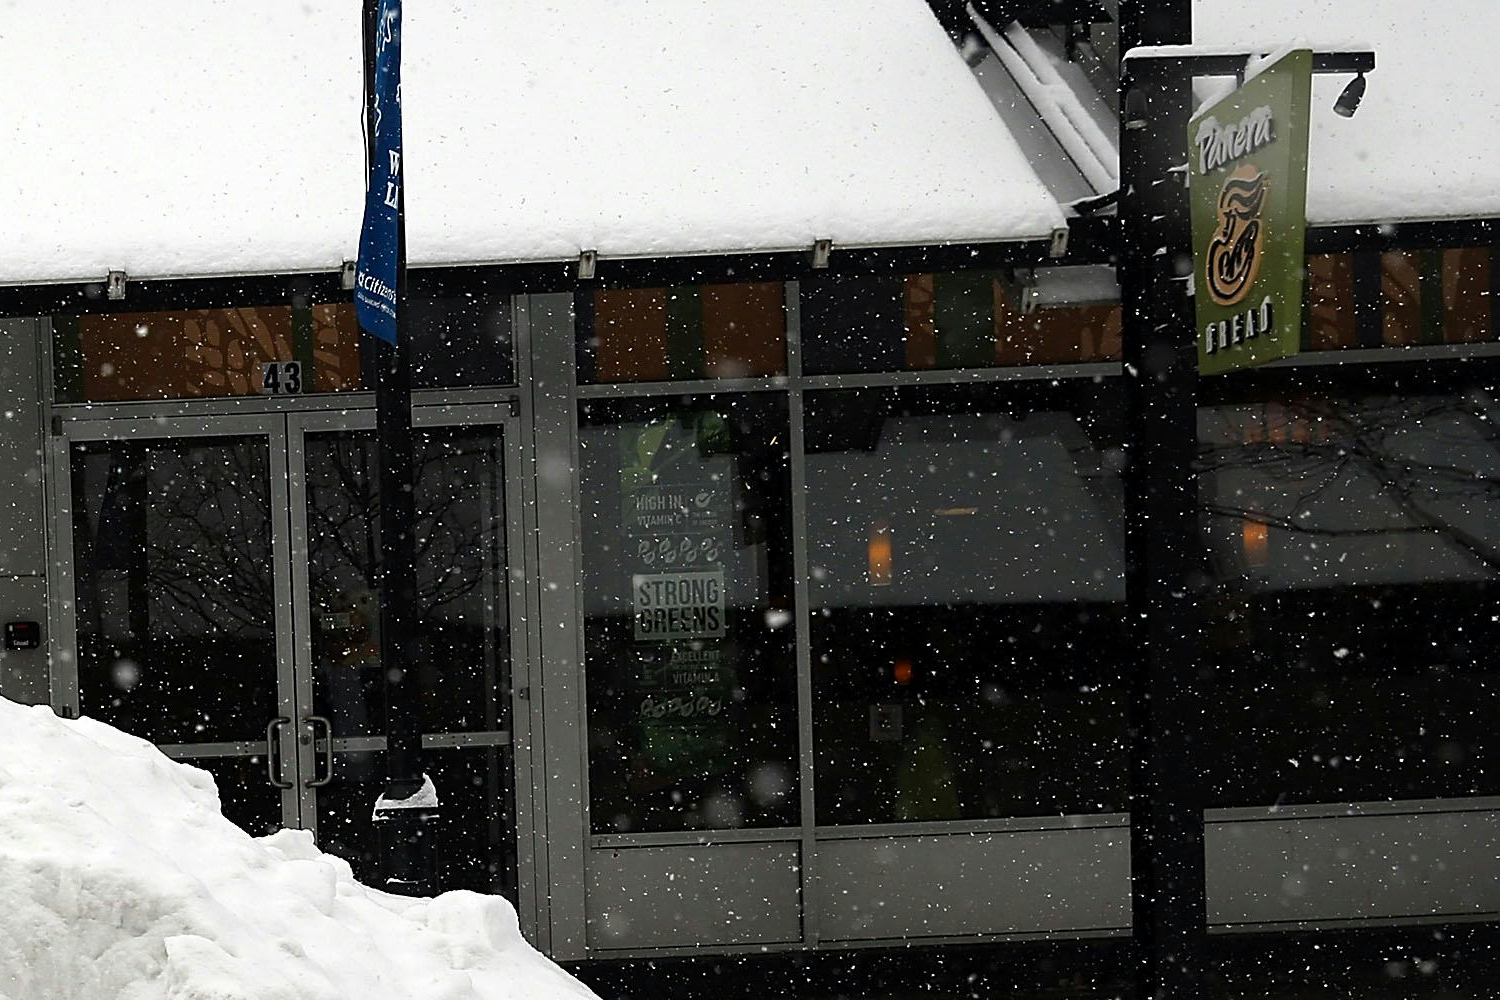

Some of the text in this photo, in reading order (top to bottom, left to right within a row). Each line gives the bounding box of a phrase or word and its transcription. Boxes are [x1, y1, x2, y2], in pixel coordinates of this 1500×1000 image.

[1196, 106, 1275, 174] Panera
[263, 362, 301, 394] 43
[635, 494, 683, 511] HIGH IN
[637, 514, 674, 526] VITAMIN
[639, 578, 719, 606] STRONG
[640, 605, 720, 634] GREENS
